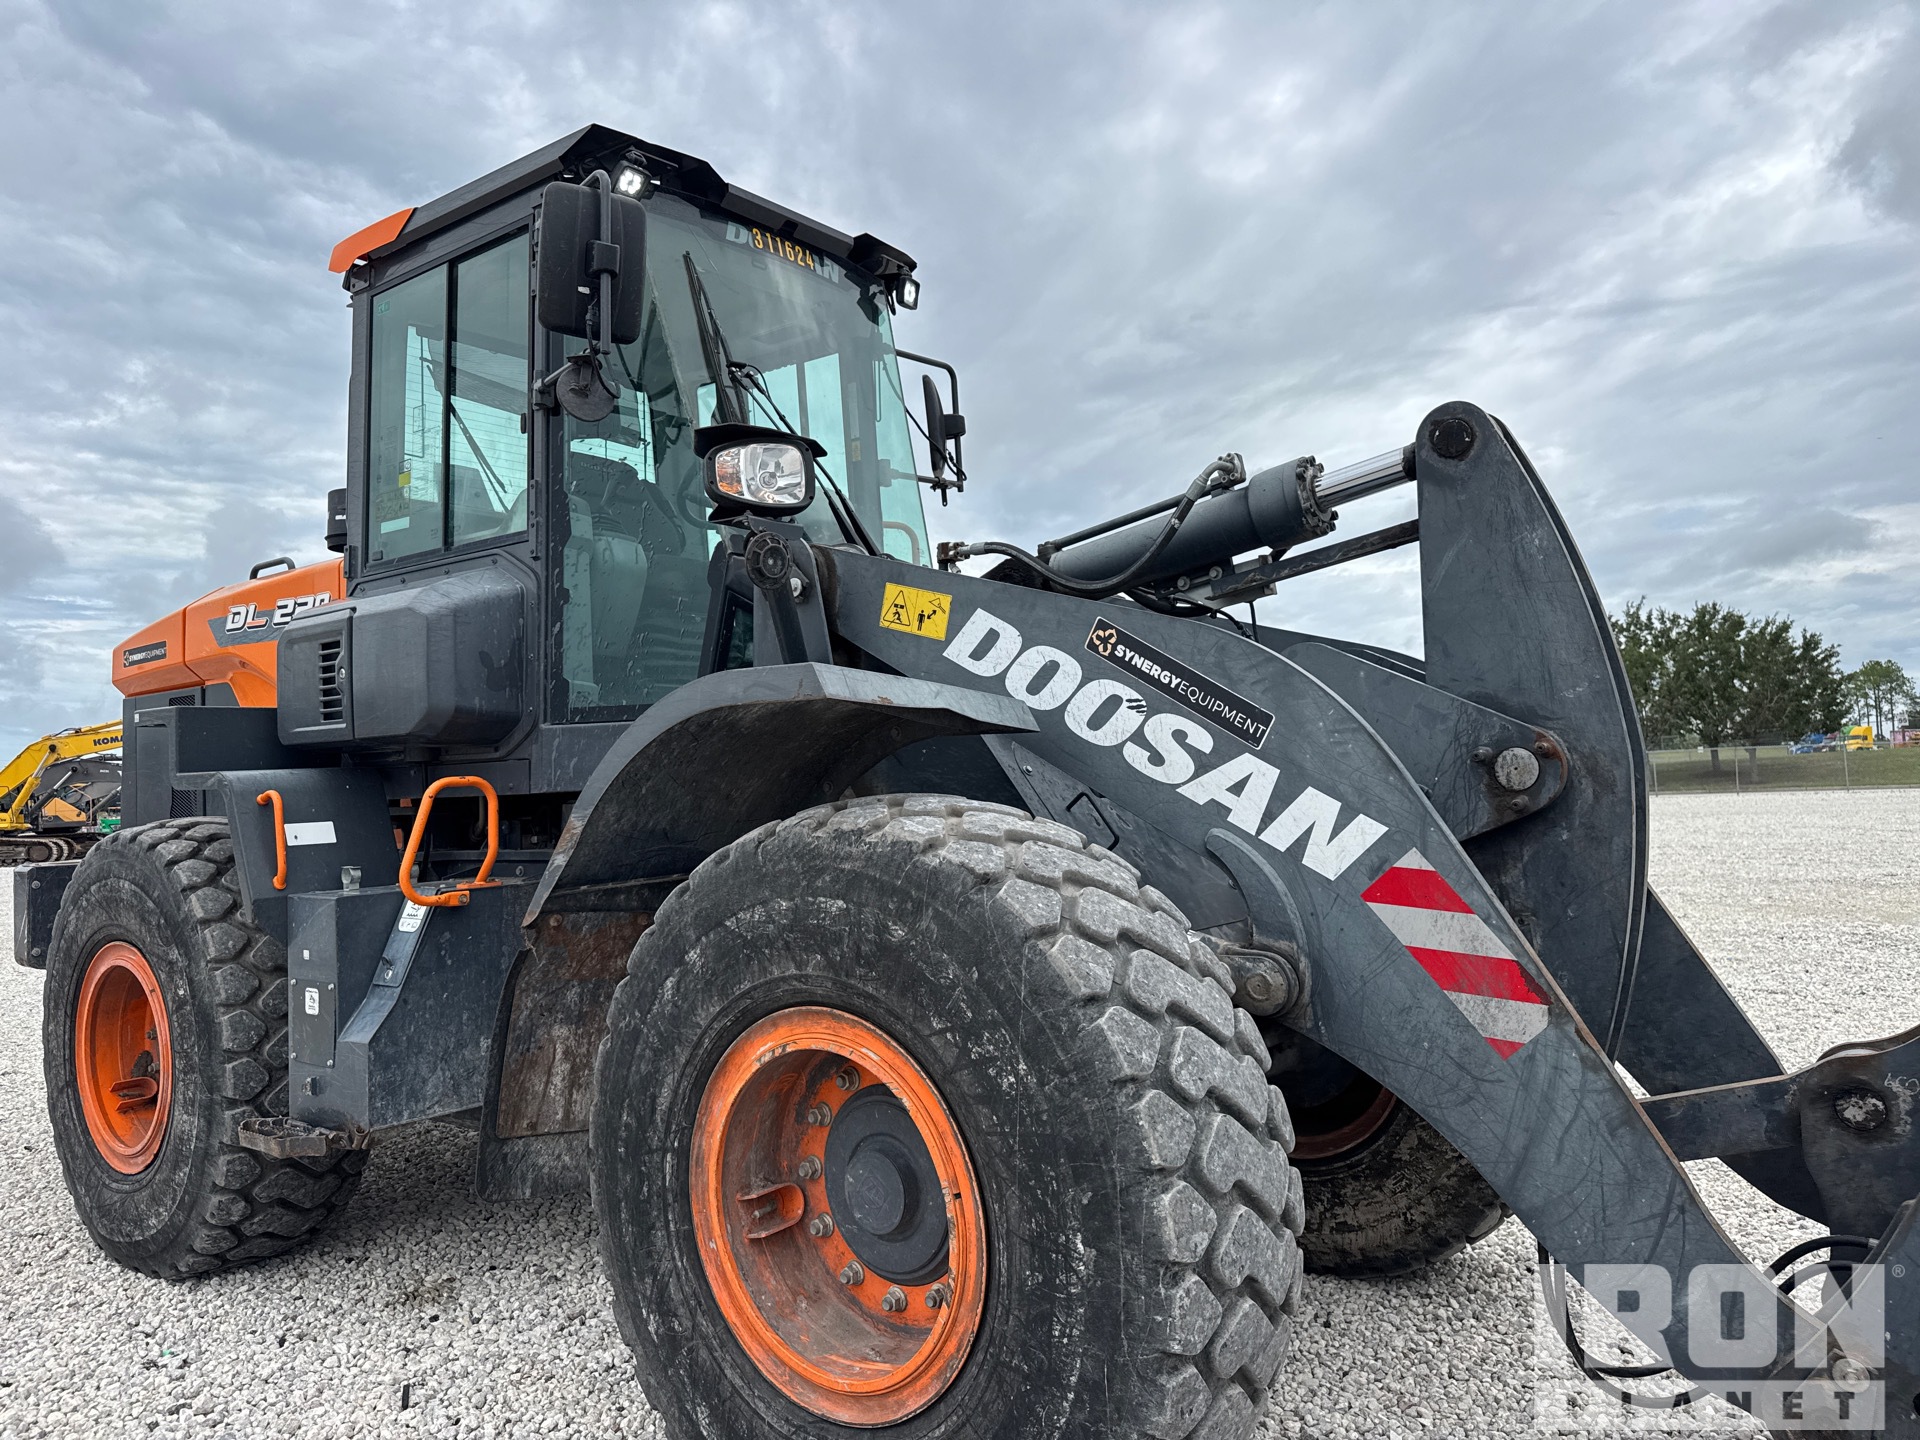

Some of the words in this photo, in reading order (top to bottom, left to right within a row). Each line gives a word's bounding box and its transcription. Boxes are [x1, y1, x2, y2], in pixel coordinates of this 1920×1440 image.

[752, 228, 815, 270] 311624
[225, 603, 268, 634] DL
[92, 735, 123, 746] KOM
[943, 608, 1389, 881] DOOSAN
